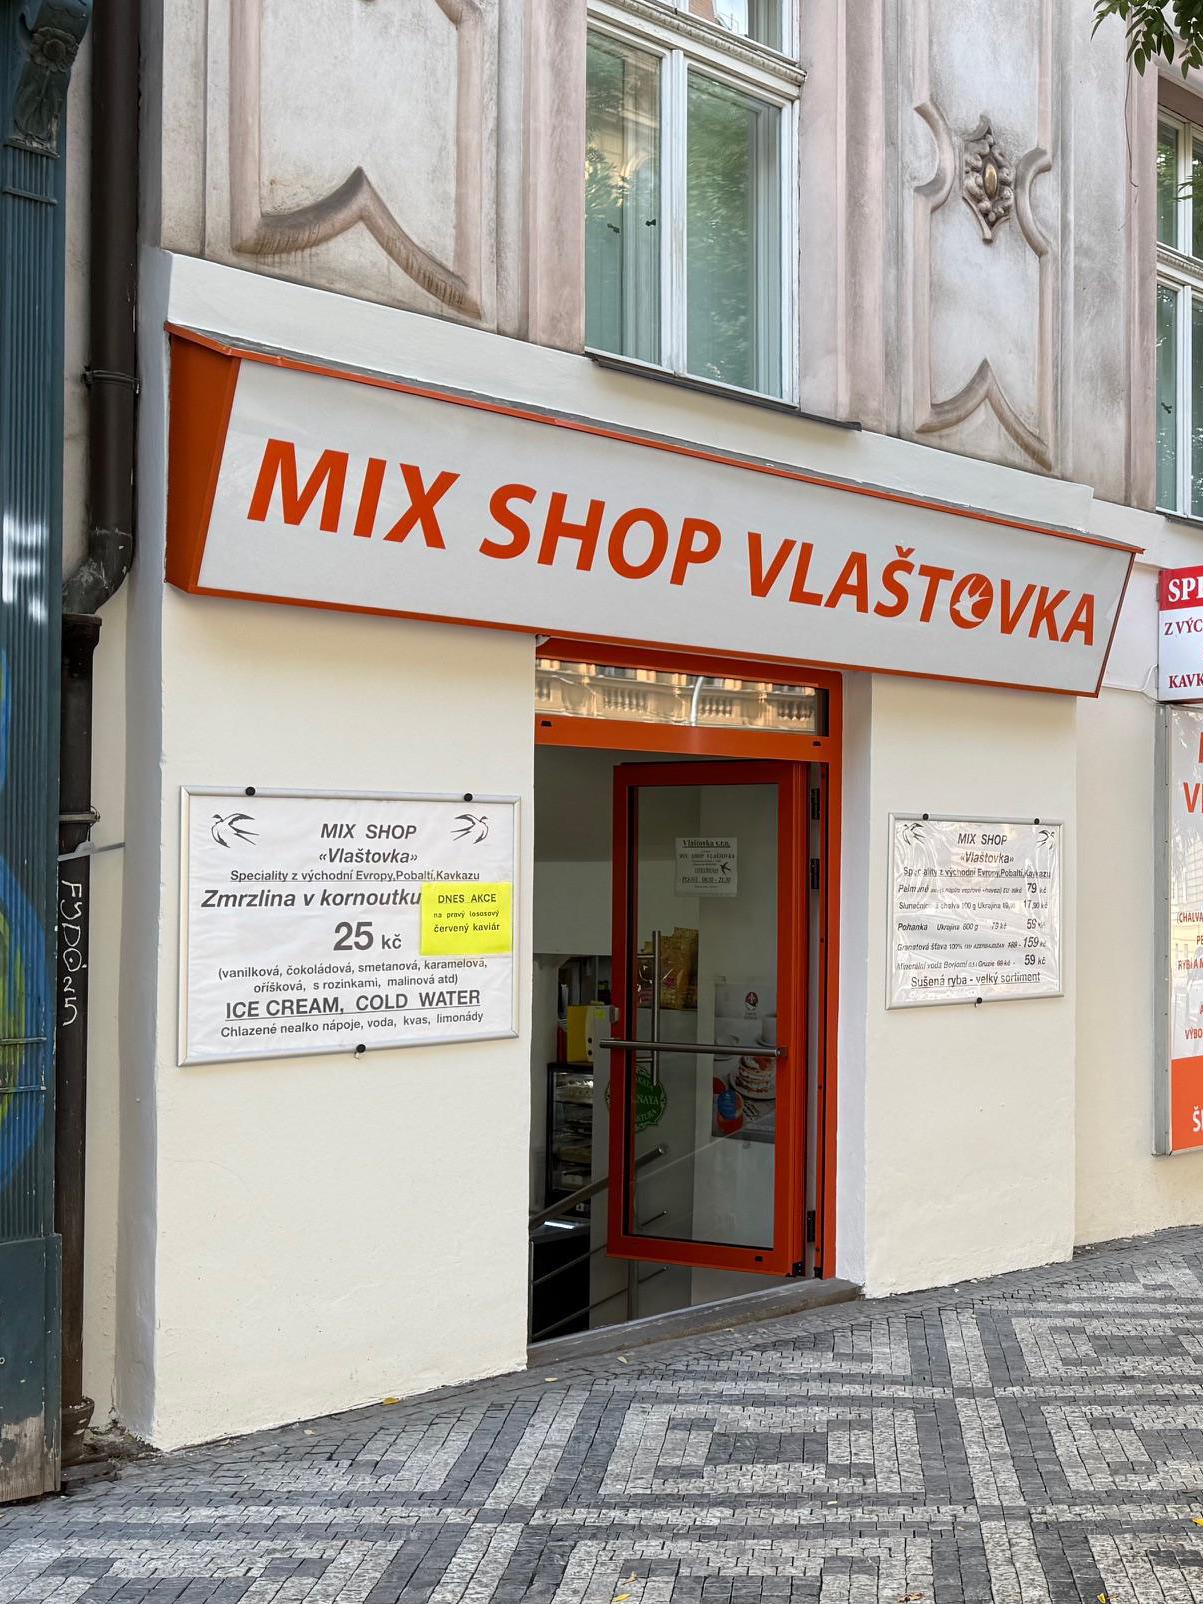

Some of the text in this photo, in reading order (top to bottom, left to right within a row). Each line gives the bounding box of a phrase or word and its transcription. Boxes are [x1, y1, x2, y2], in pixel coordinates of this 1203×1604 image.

[248, 438, 1096, 648] MIX SHOP VLAŠTOVKA
[1165, 622, 1173, 635] Z
[321, 823, 416, 840] MIX SHOP
[957, 833, 1007, 845] MIX SHOP
[230, 870, 288, 883] Speciality
[291, 872, 299, 880] z
[301, 870, 353, 882] východní
[1027, 883, 1037, 894] 79
[201, 889, 296, 908] Zmrzlina
[304, 893, 315, 906] v
[438, 893, 496, 904] DNES AKCE
[433, 922, 500, 934] červený kaviár
[333, 922, 402, 951] 25 kč
[1023, 937, 1039, 948] 159
[1024, 955, 1035, 966] 59
[1194, 959, 1198, 969] A
[218, 958, 487, 982] (vanilková, čokoládová, smetanová, karamelová,
[313, 982, 319, 990] s
[322, 978, 381, 990] rozinkami,
[387, 974, 434, 986] malinová
[438, 973, 458, 986] atd)
[948, 976, 967, 987] ryba
[226, 989, 480, 1019] ICE CREAM, COLD WATER
[221, 1010, 483, 1038] Chlazené nealko nápoje, voda, kvas, limonády
